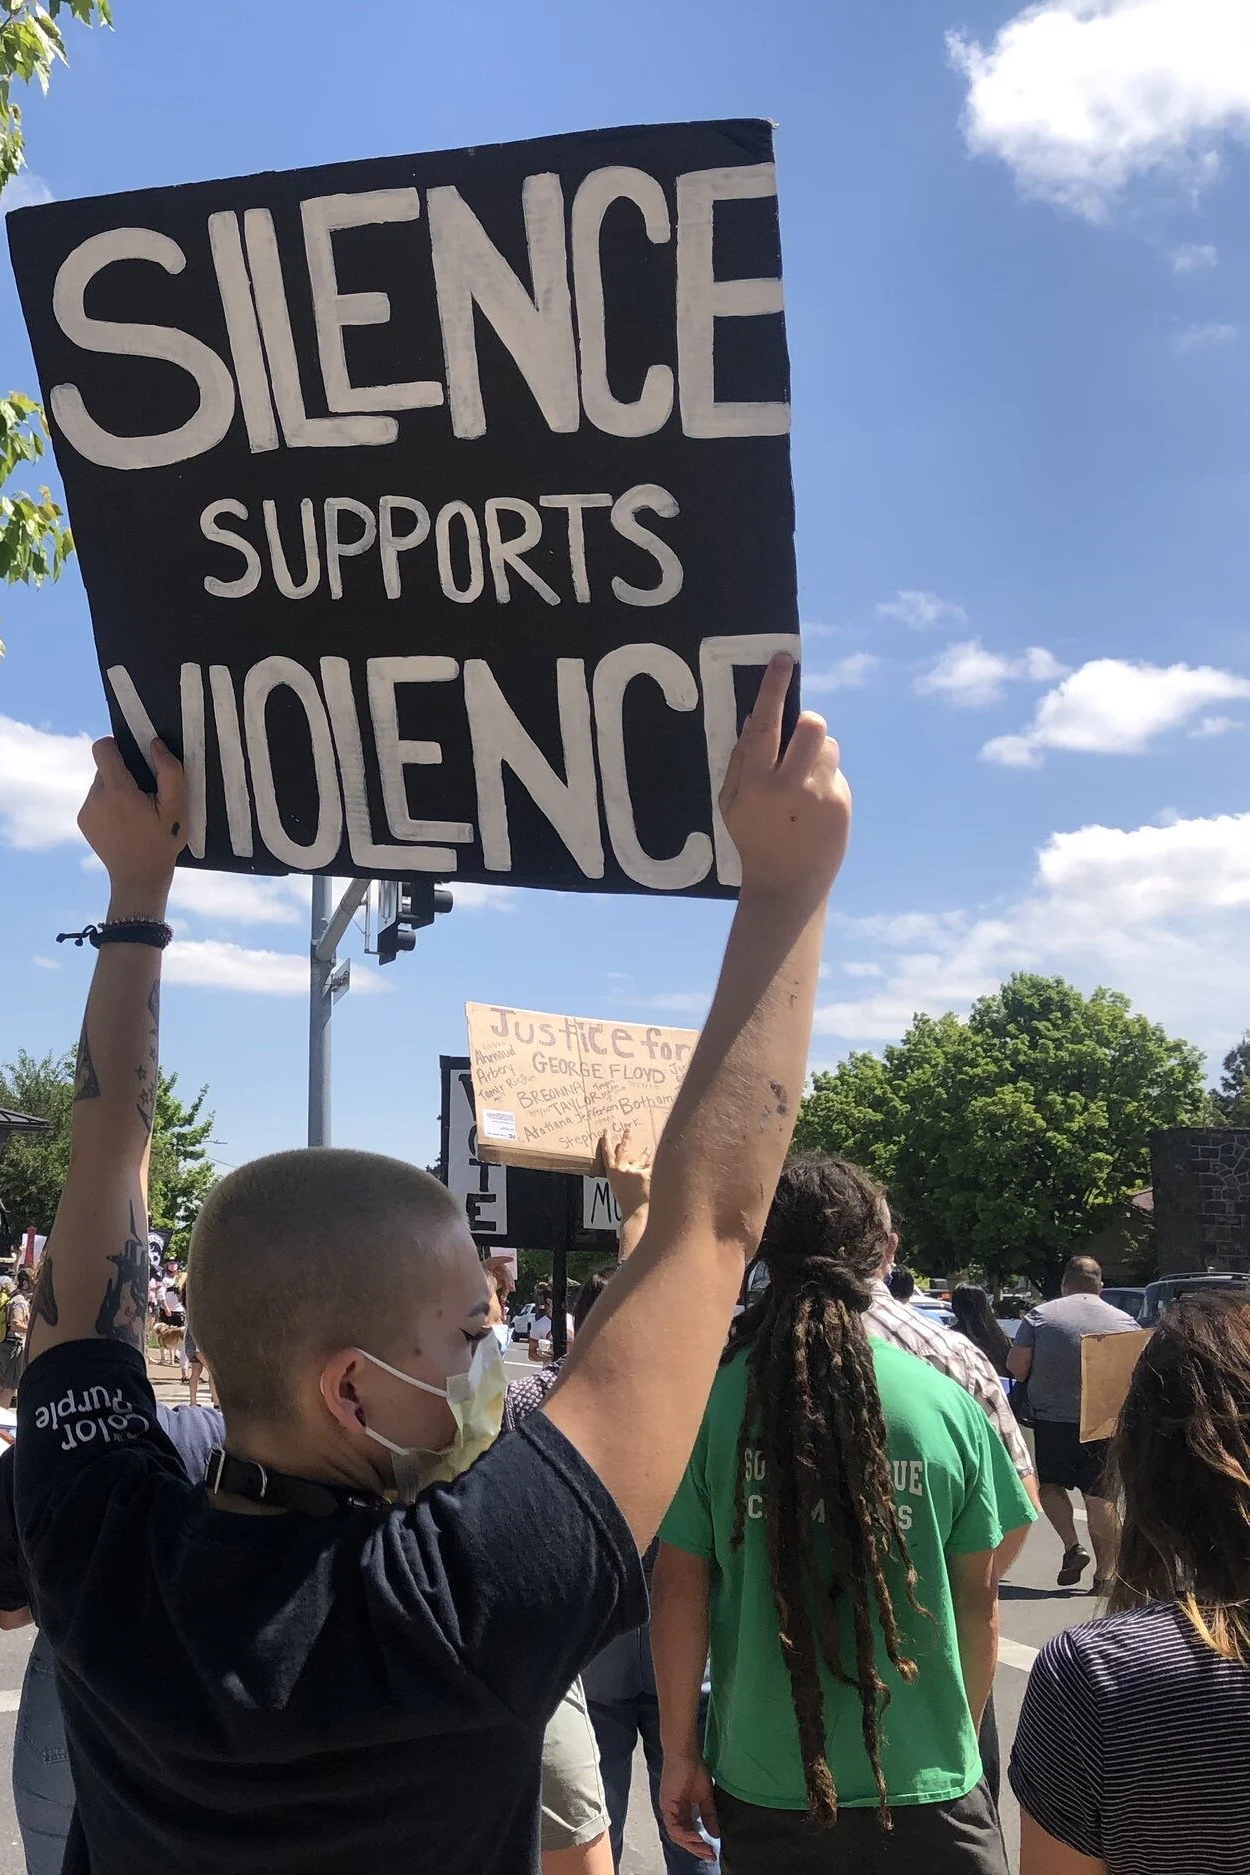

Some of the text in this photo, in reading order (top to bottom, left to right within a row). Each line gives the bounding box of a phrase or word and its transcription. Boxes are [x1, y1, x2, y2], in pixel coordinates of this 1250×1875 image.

[50, 162, 791, 470] SILENCE
[200, 484, 683, 607] SUPPORTS
[490, 1007, 692, 1061] Justice for
[532, 1051, 666, 1084] GEORGE FLOYD
[517, 1081, 586, 1110] BREONNA
[548, 1091, 602, 1117] TAYLOR
[619, 1095, 673, 1116] Botham
[35, 1385, 133, 1430] Purple
[61, 1413, 149, 1450] Color
